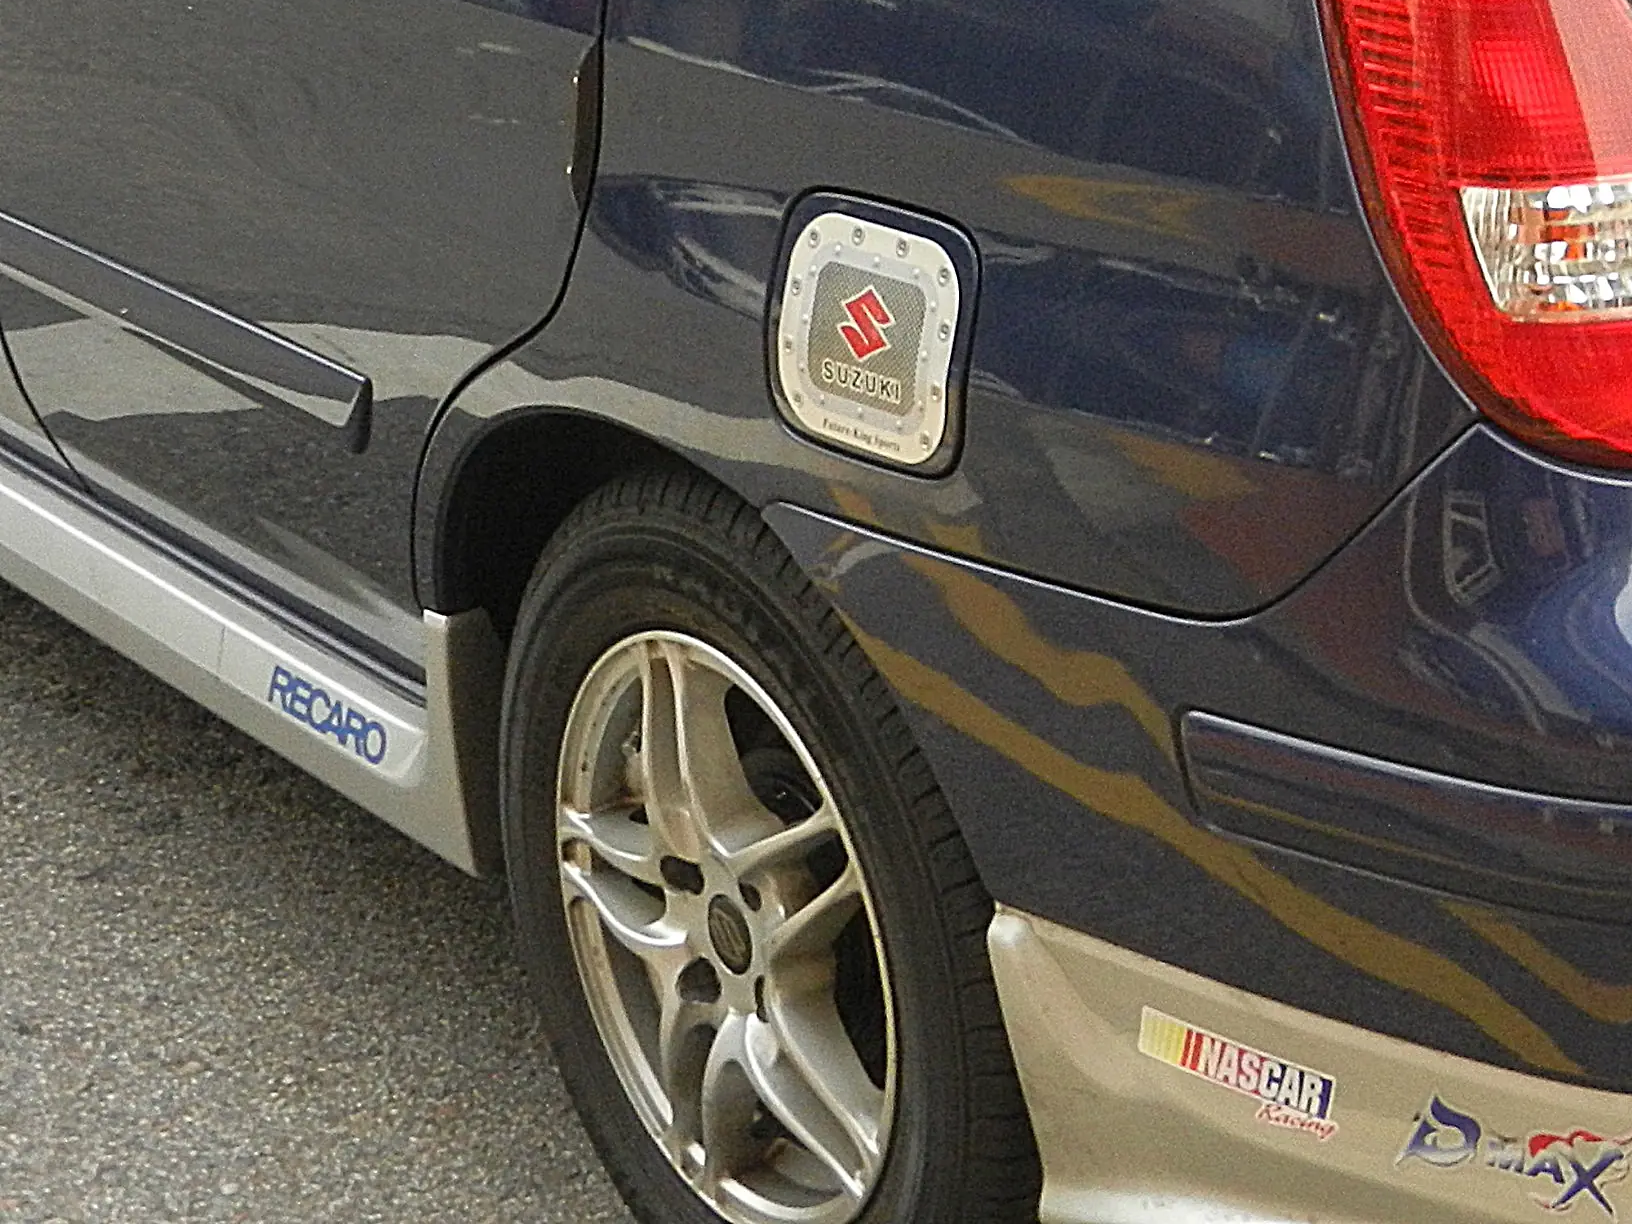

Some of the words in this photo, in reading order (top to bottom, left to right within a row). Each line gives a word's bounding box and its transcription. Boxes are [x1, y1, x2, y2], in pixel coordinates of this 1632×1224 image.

[821, 358, 901, 404] SUZUKI
[268, 665, 387, 765] RECARO
[1199, 1036, 1323, 1118] NASCAR
[1256, 1102, 1340, 1141] Racing
